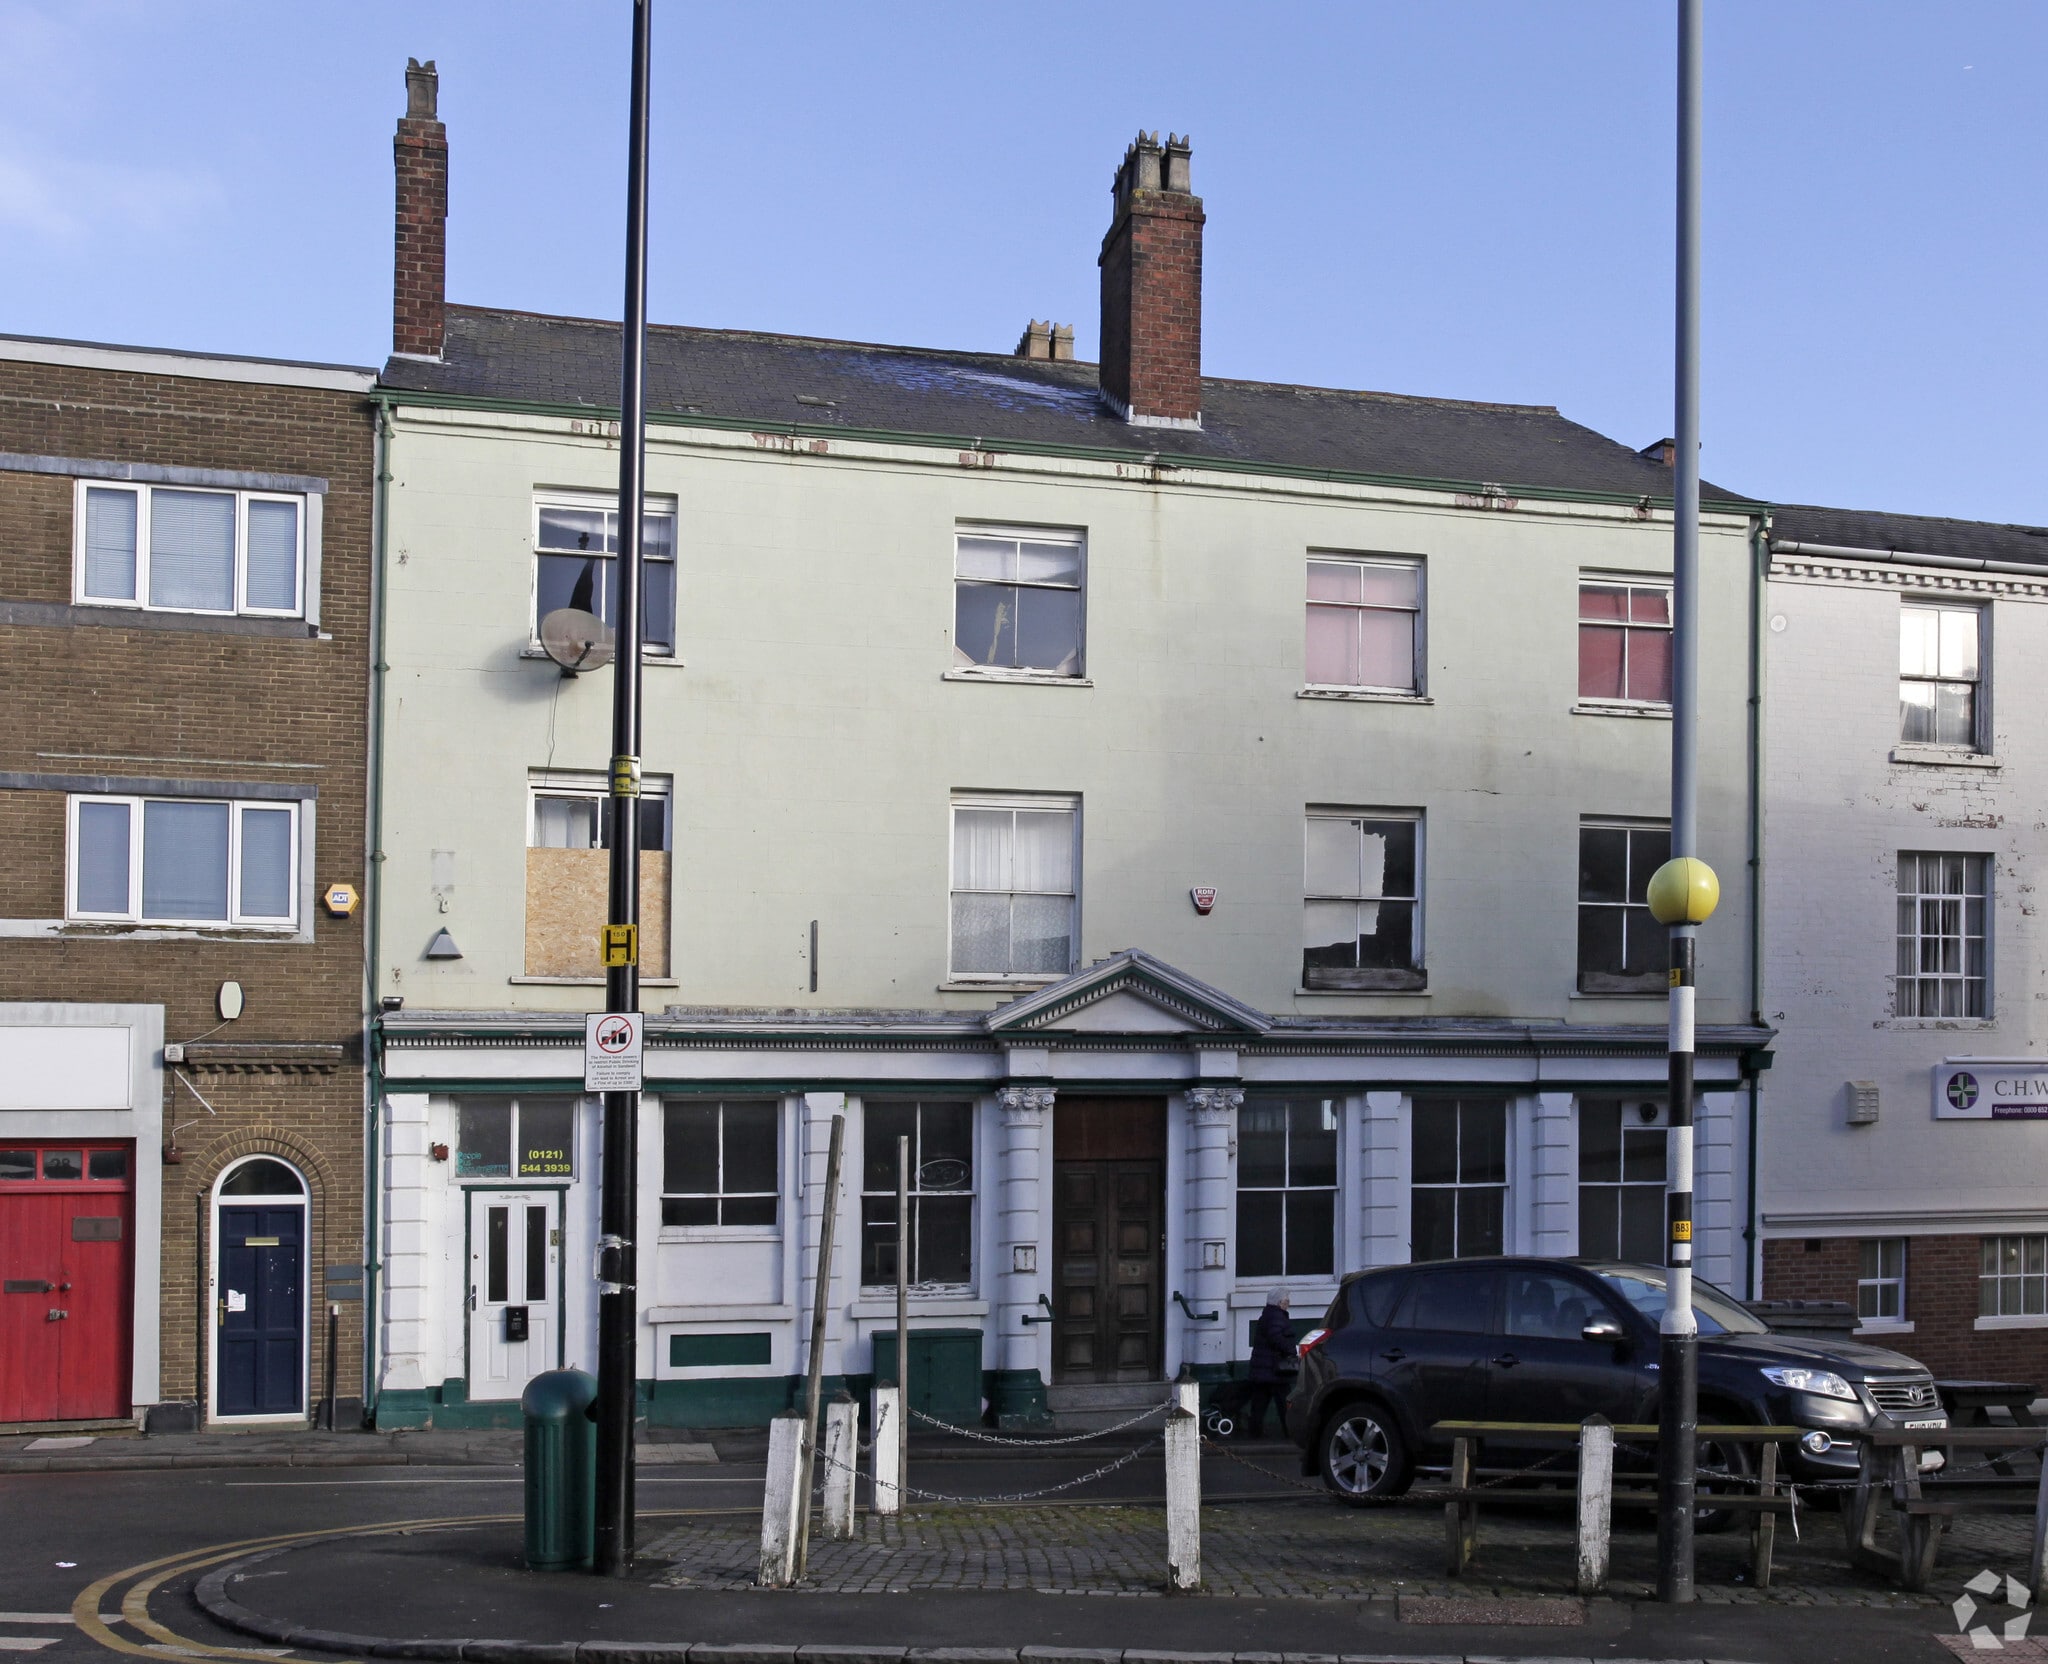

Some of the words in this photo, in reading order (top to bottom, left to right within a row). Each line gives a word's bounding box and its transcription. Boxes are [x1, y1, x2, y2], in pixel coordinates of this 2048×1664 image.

[332, 894, 348, 902] ADT
[606, 929, 632, 962] H
[528, 1150, 563, 1160] (0121)
[1675, 1223, 1689, 1233] BB3
